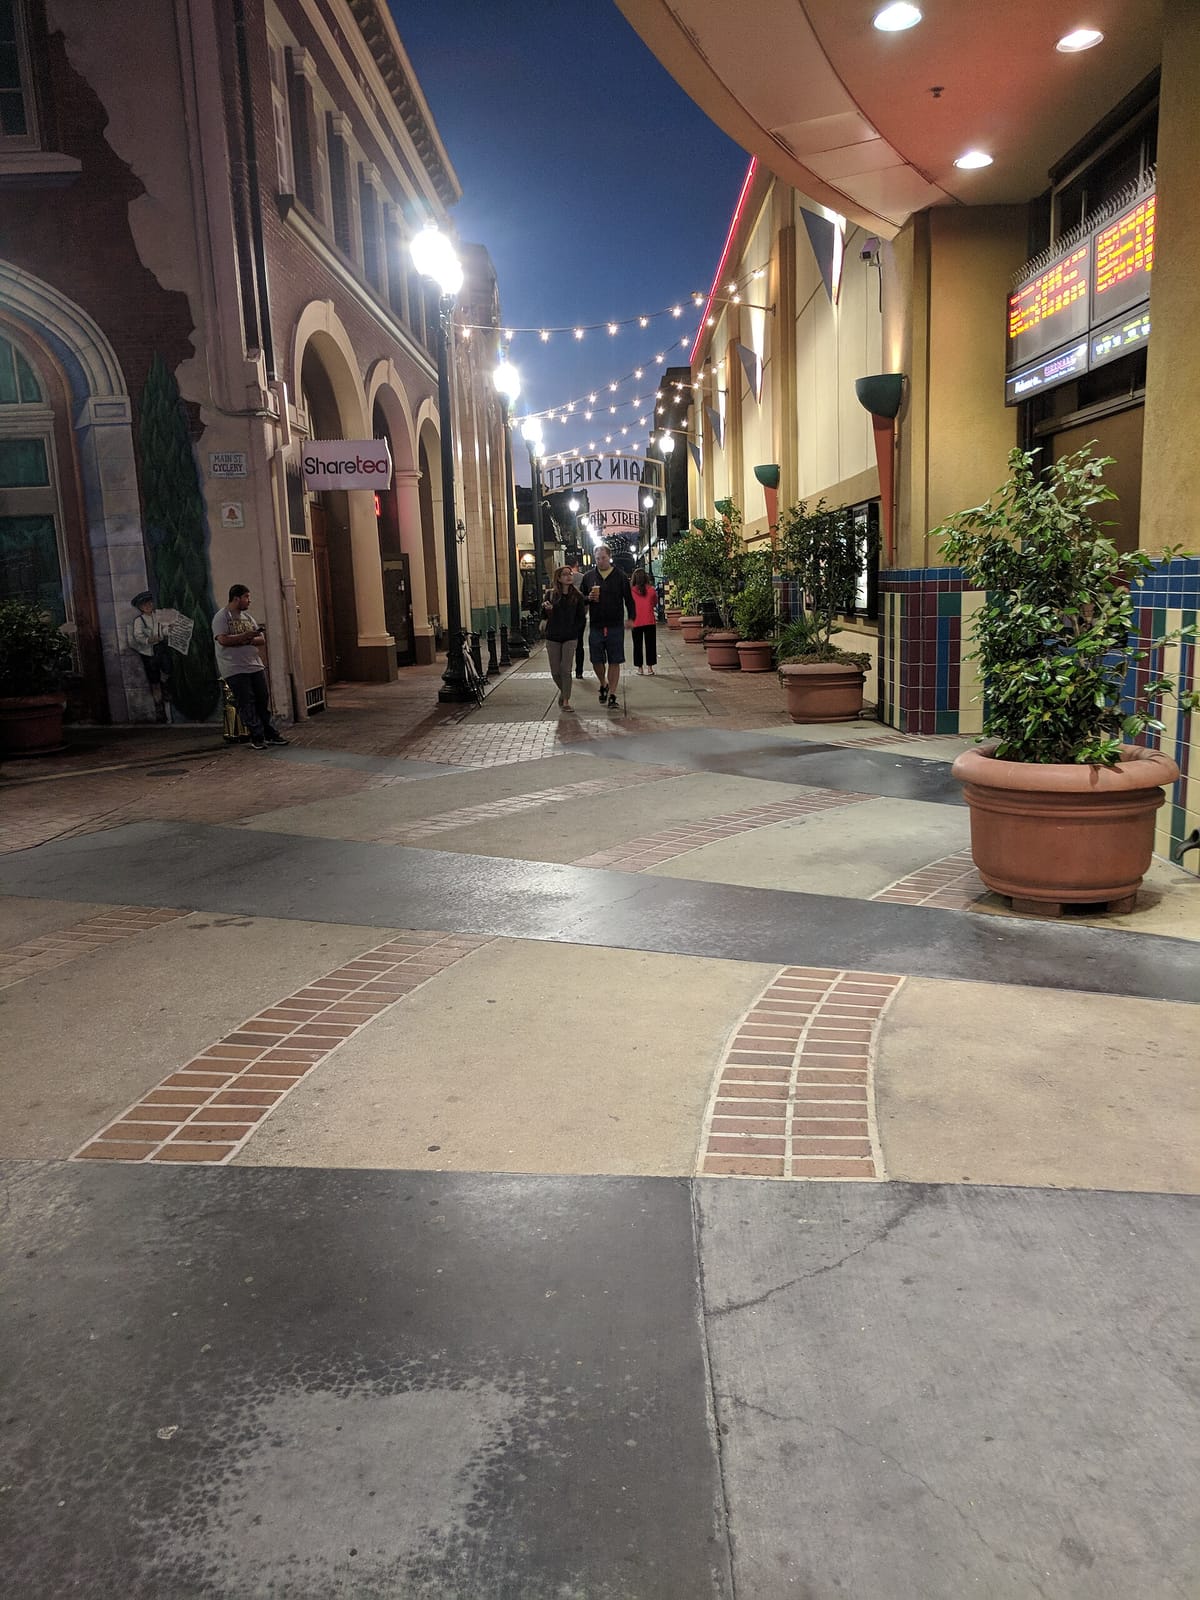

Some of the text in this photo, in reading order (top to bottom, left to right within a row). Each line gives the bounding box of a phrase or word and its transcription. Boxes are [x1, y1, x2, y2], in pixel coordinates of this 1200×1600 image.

[213, 463, 243, 473] CYCLERY
[304, 455, 388, 475] Sharetea
[611, 511, 640, 526] STREE
